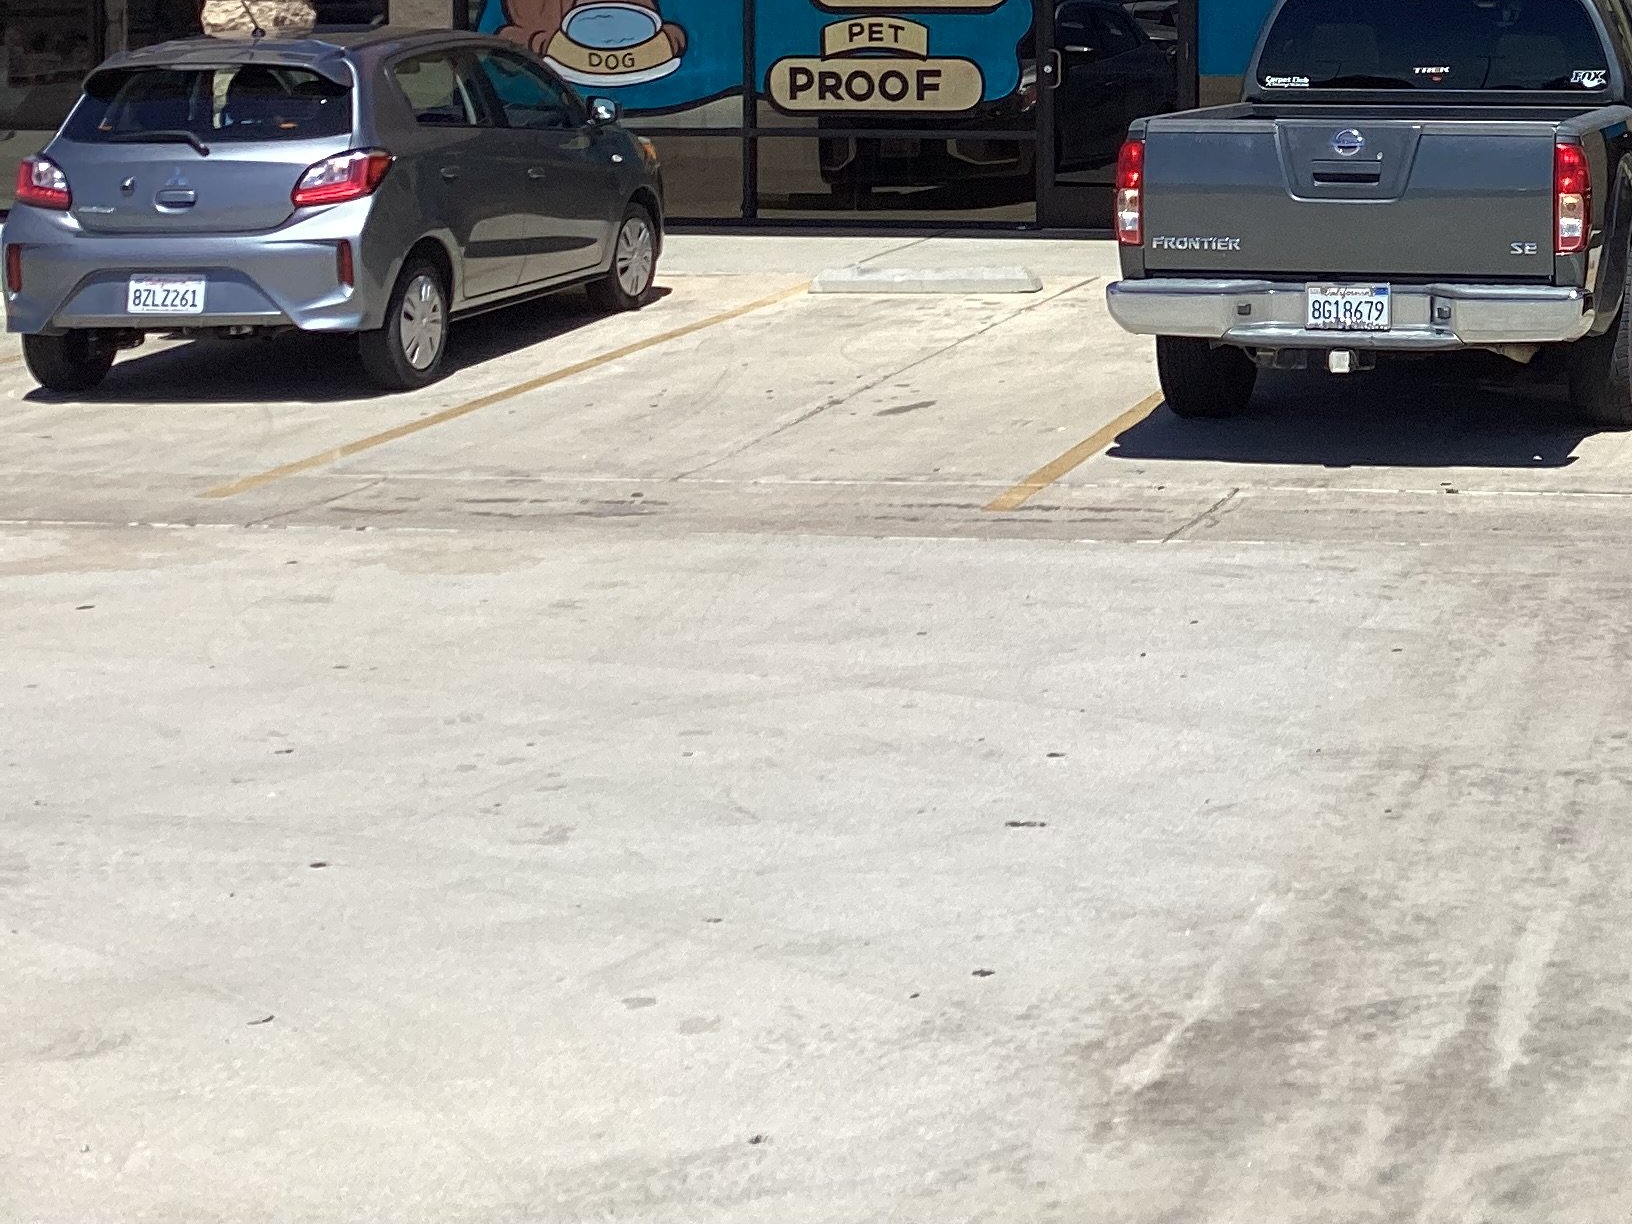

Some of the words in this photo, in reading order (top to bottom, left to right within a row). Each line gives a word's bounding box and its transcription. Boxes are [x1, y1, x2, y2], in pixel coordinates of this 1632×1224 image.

[847, 22, 906, 46] PET
[588, 51, 636, 71] DOG
[787, 66, 943, 103] PROOF
[1570, 70, 1607, 83] FOX
[1152, 236, 1241, 251] FRONTIER
[1510, 242, 1537, 255] SE
[1311, 300, 1385, 322] 8G18679
